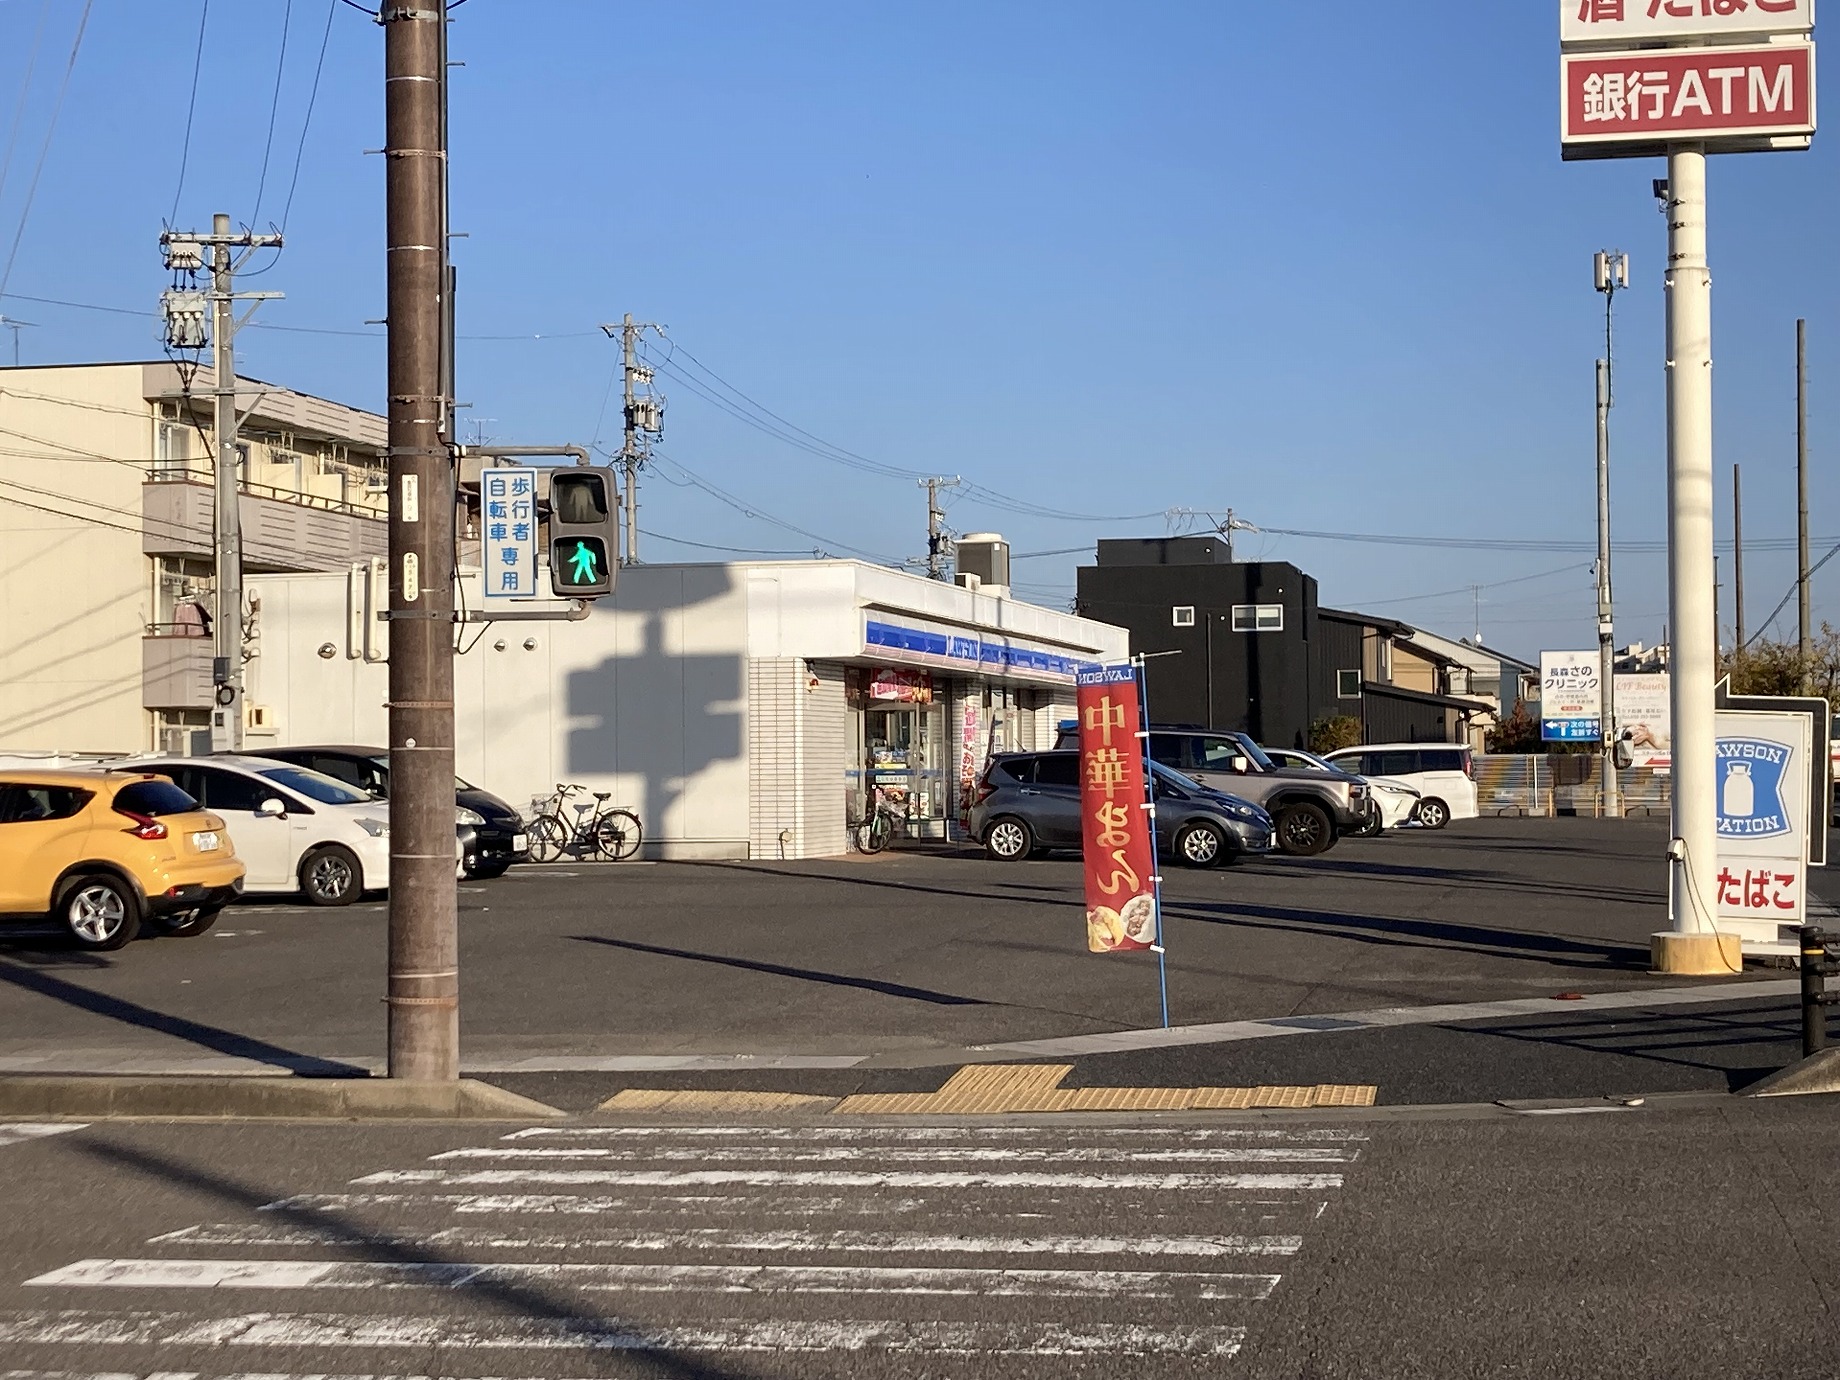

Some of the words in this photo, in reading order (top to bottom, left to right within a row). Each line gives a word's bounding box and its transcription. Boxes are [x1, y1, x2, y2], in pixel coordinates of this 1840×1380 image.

[1582, 64, 1793, 122] 銀行ATM
[489, 478, 508, 542] 自転車
[511, 477, 530, 542] 歩行者
[501, 547, 519, 591] 専用
[1544, 678, 1598, 690] クリニック
[1550, 665, 1593, 677] 長森さの
[1716, 743, 1783, 764] AWSON
[1716, 815, 1780, 833] ATION
[1717, 866, 1796, 910] たばこ
